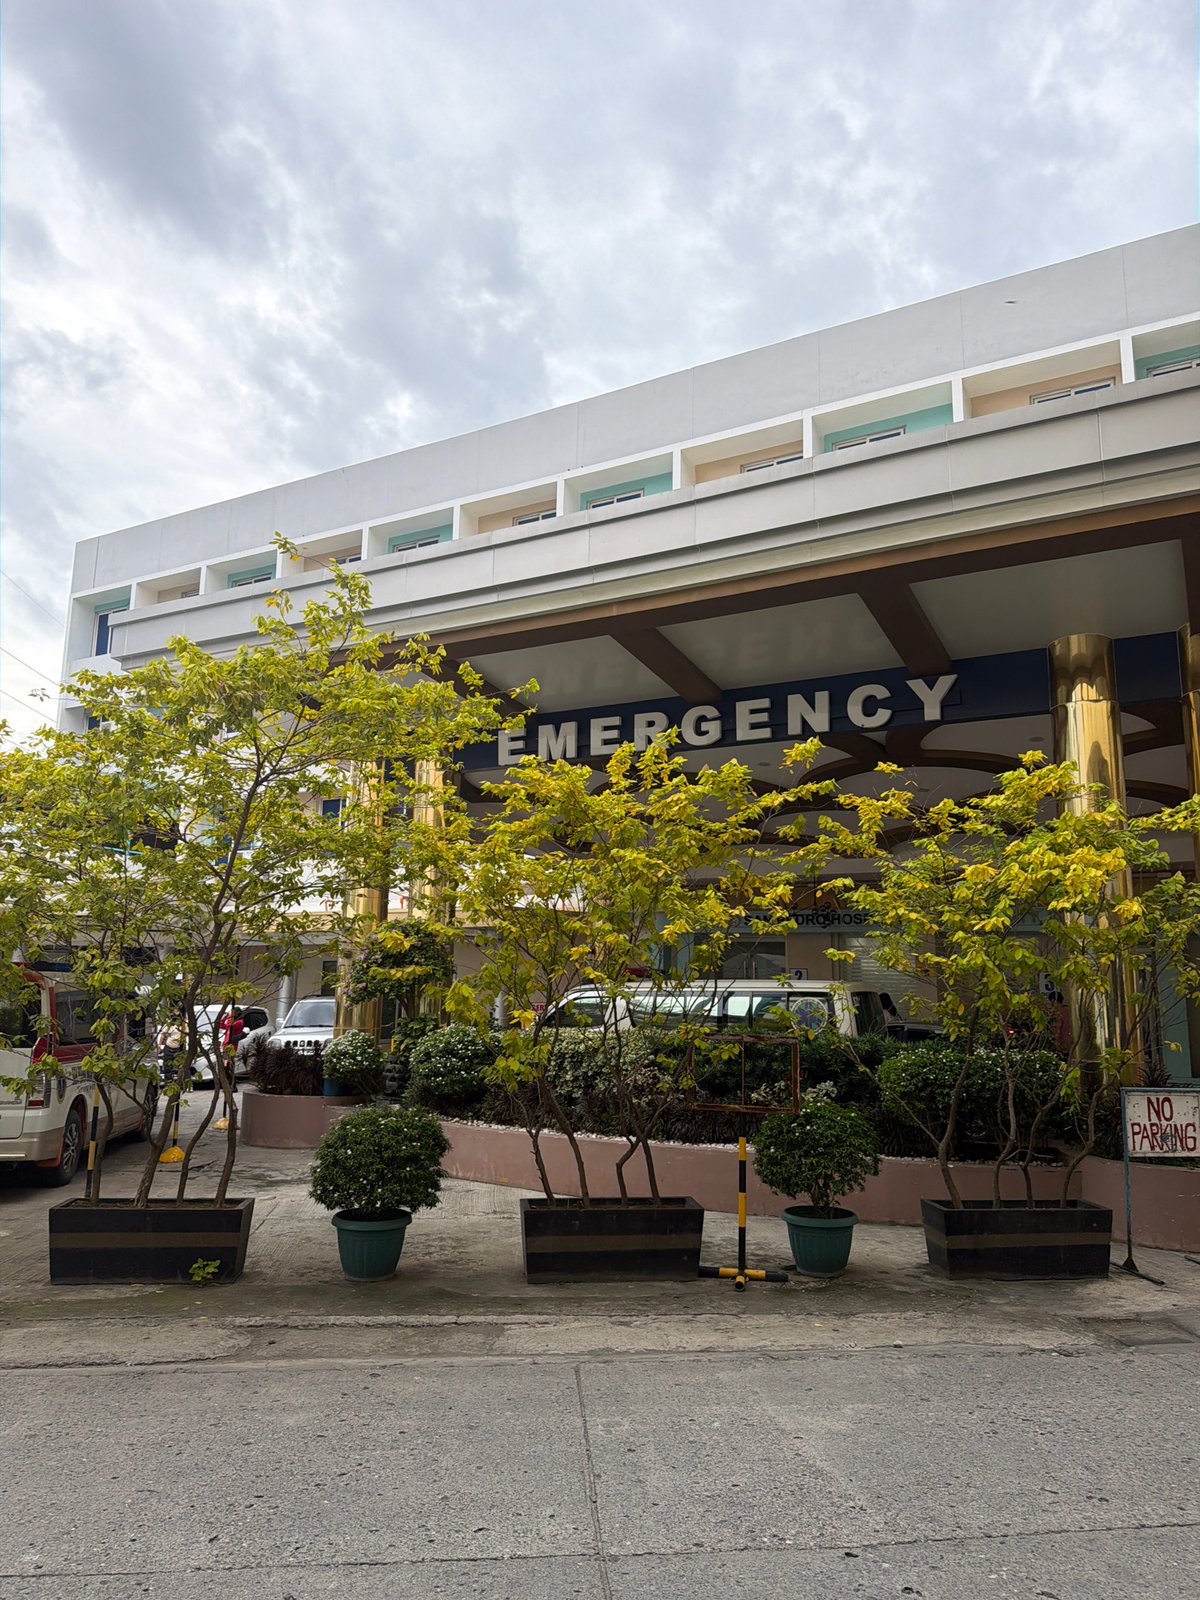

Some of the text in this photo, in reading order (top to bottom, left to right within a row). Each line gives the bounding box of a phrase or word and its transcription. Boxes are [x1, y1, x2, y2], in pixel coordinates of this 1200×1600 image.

[498, 674, 958, 766] EMERGENCY
[1146, 1096, 1174, 1122] NO
[1131, 1122, 1197, 1152] PARKING
